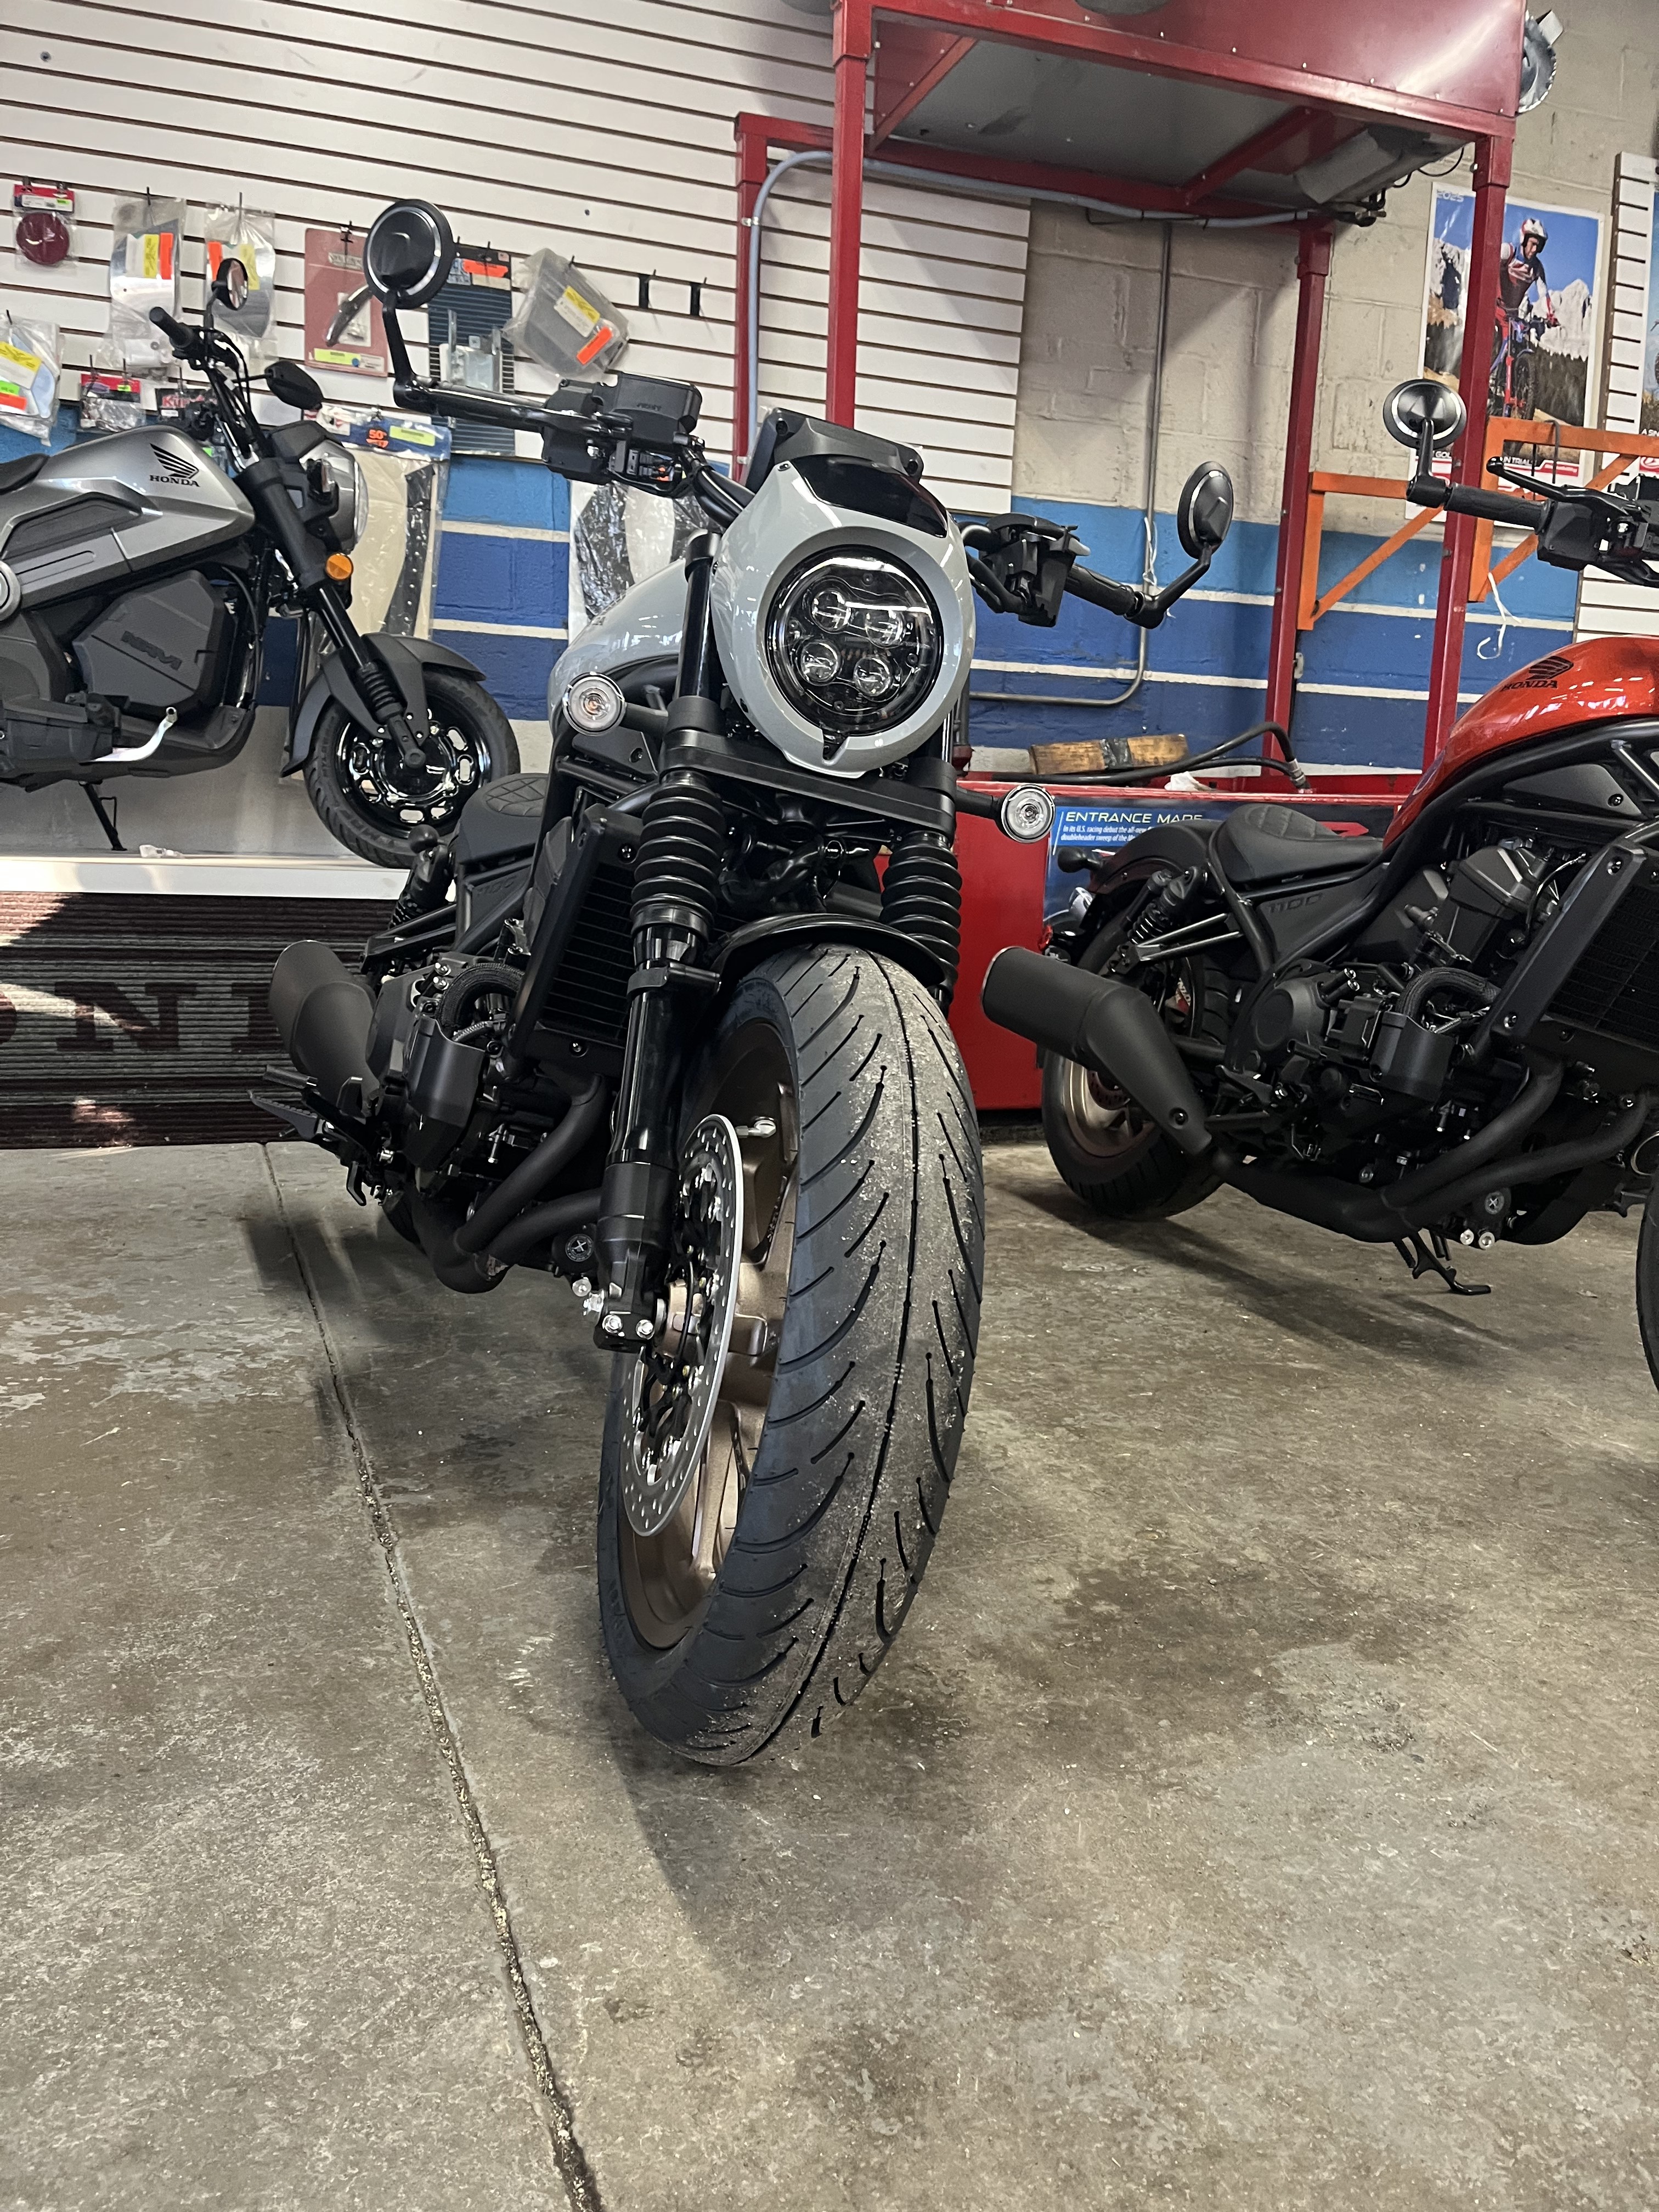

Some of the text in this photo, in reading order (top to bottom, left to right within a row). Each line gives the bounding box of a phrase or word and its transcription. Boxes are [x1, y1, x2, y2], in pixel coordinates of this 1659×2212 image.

[149, 475, 201, 488] HONDA
[1501, 680, 1558, 692] HONDA
[1065, 811, 1152, 823] ENTRANCE
[1268, 891, 1324, 913] 1100
